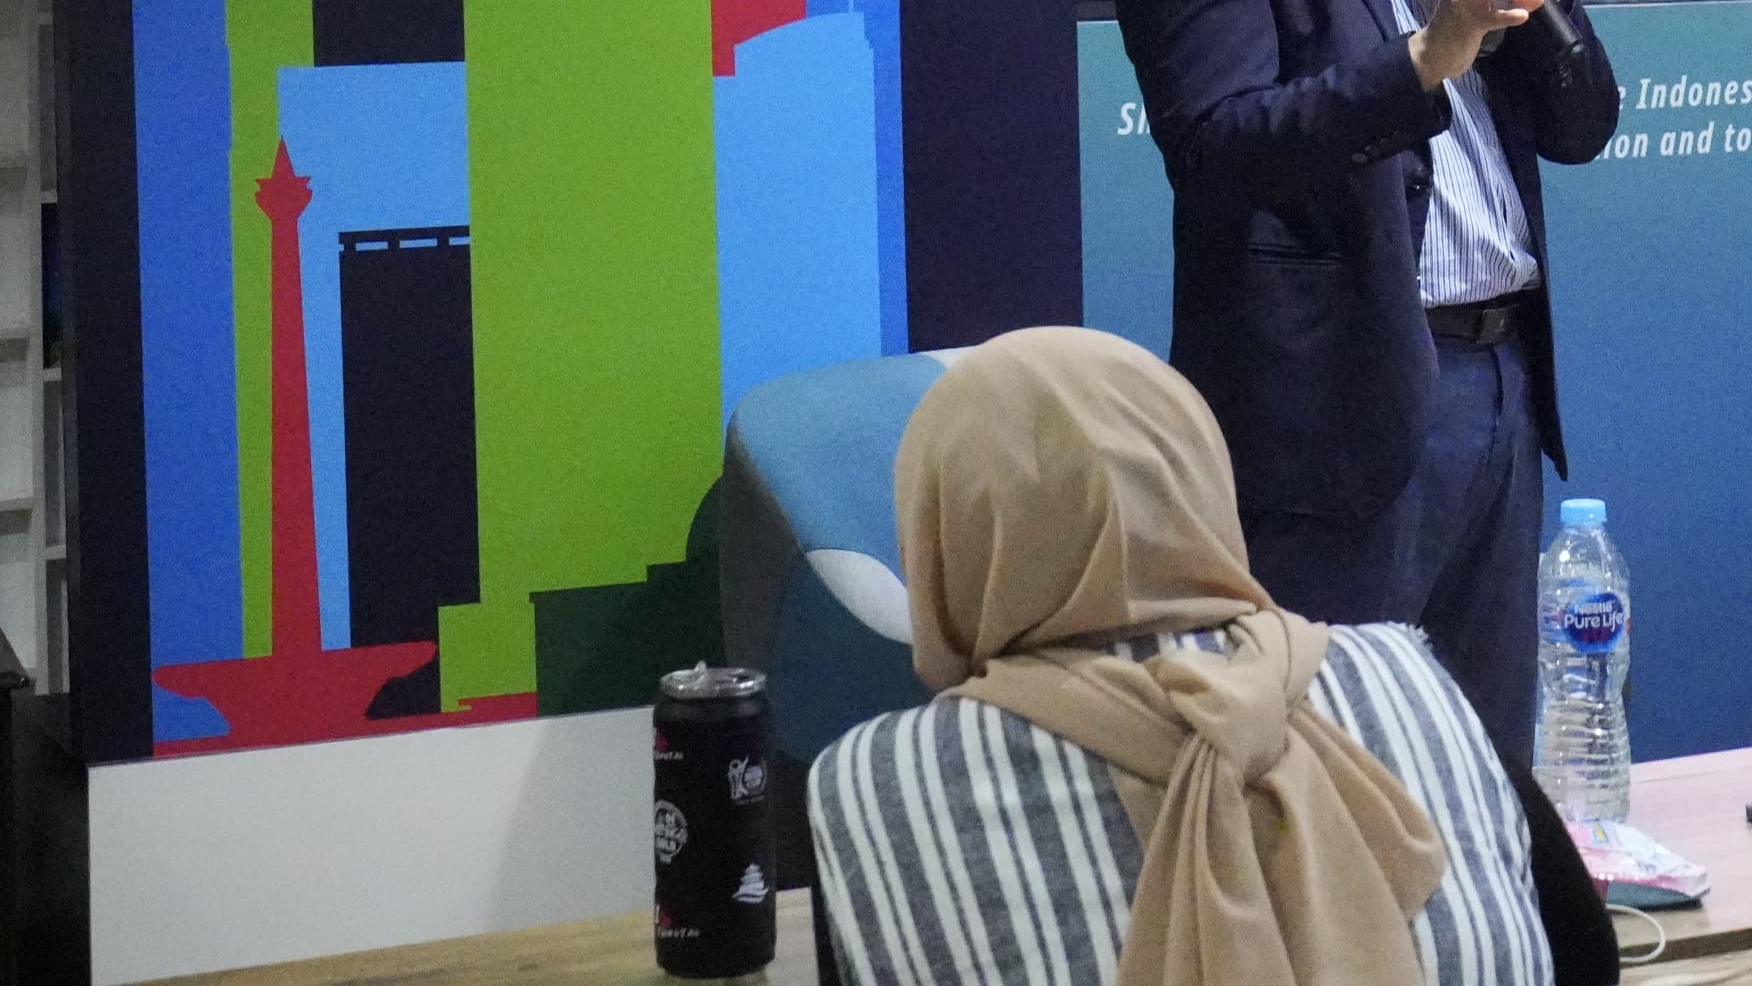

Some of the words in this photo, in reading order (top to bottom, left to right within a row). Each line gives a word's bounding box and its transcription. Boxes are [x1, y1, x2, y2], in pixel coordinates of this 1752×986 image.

[1660, 121, 1713, 156] and
[1724, 124, 1752, 154] to
[1563, 613, 1602, 630] Pure
[1602, 611, 1626, 633] Life
